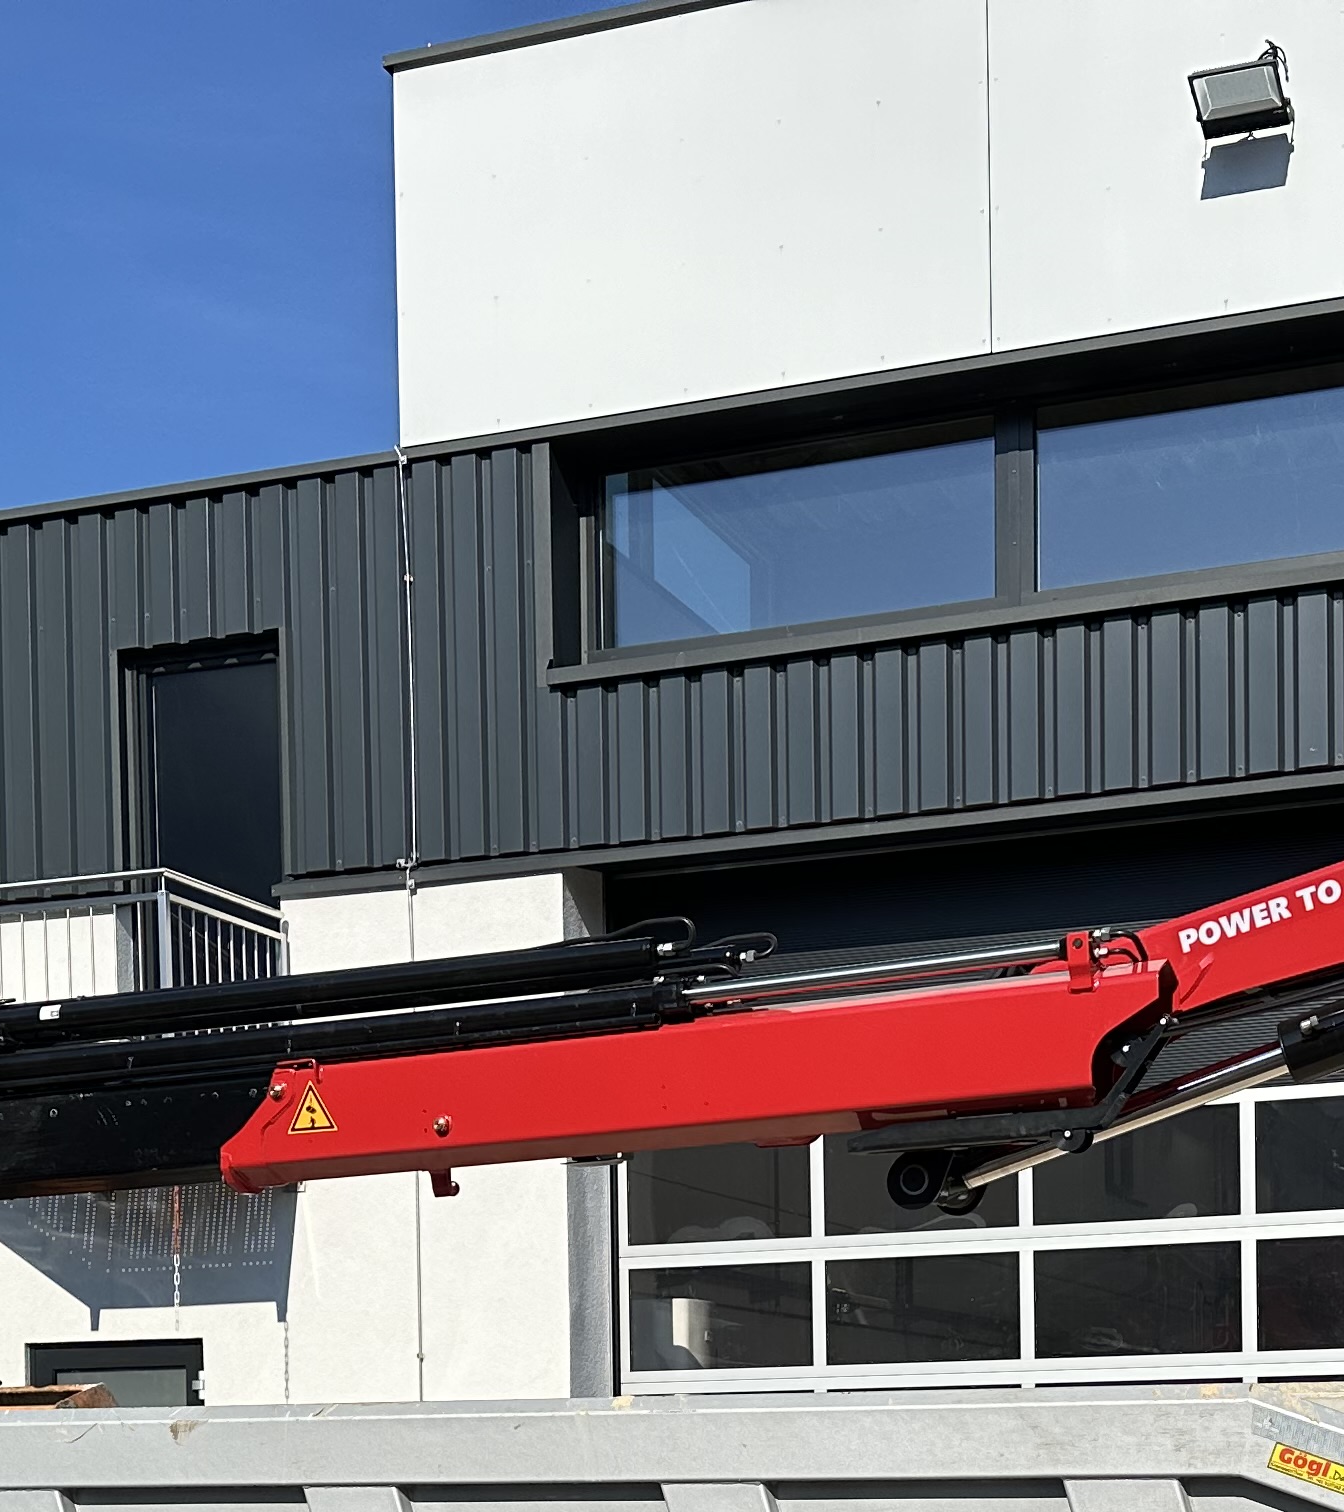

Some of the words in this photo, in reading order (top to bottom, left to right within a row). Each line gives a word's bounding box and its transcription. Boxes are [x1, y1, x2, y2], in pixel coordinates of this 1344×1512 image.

[1177, 896, 1293, 954] POWER
[1295, 879, 1342, 912] TO
[1278, 1447, 1332, 1477] Gögl
